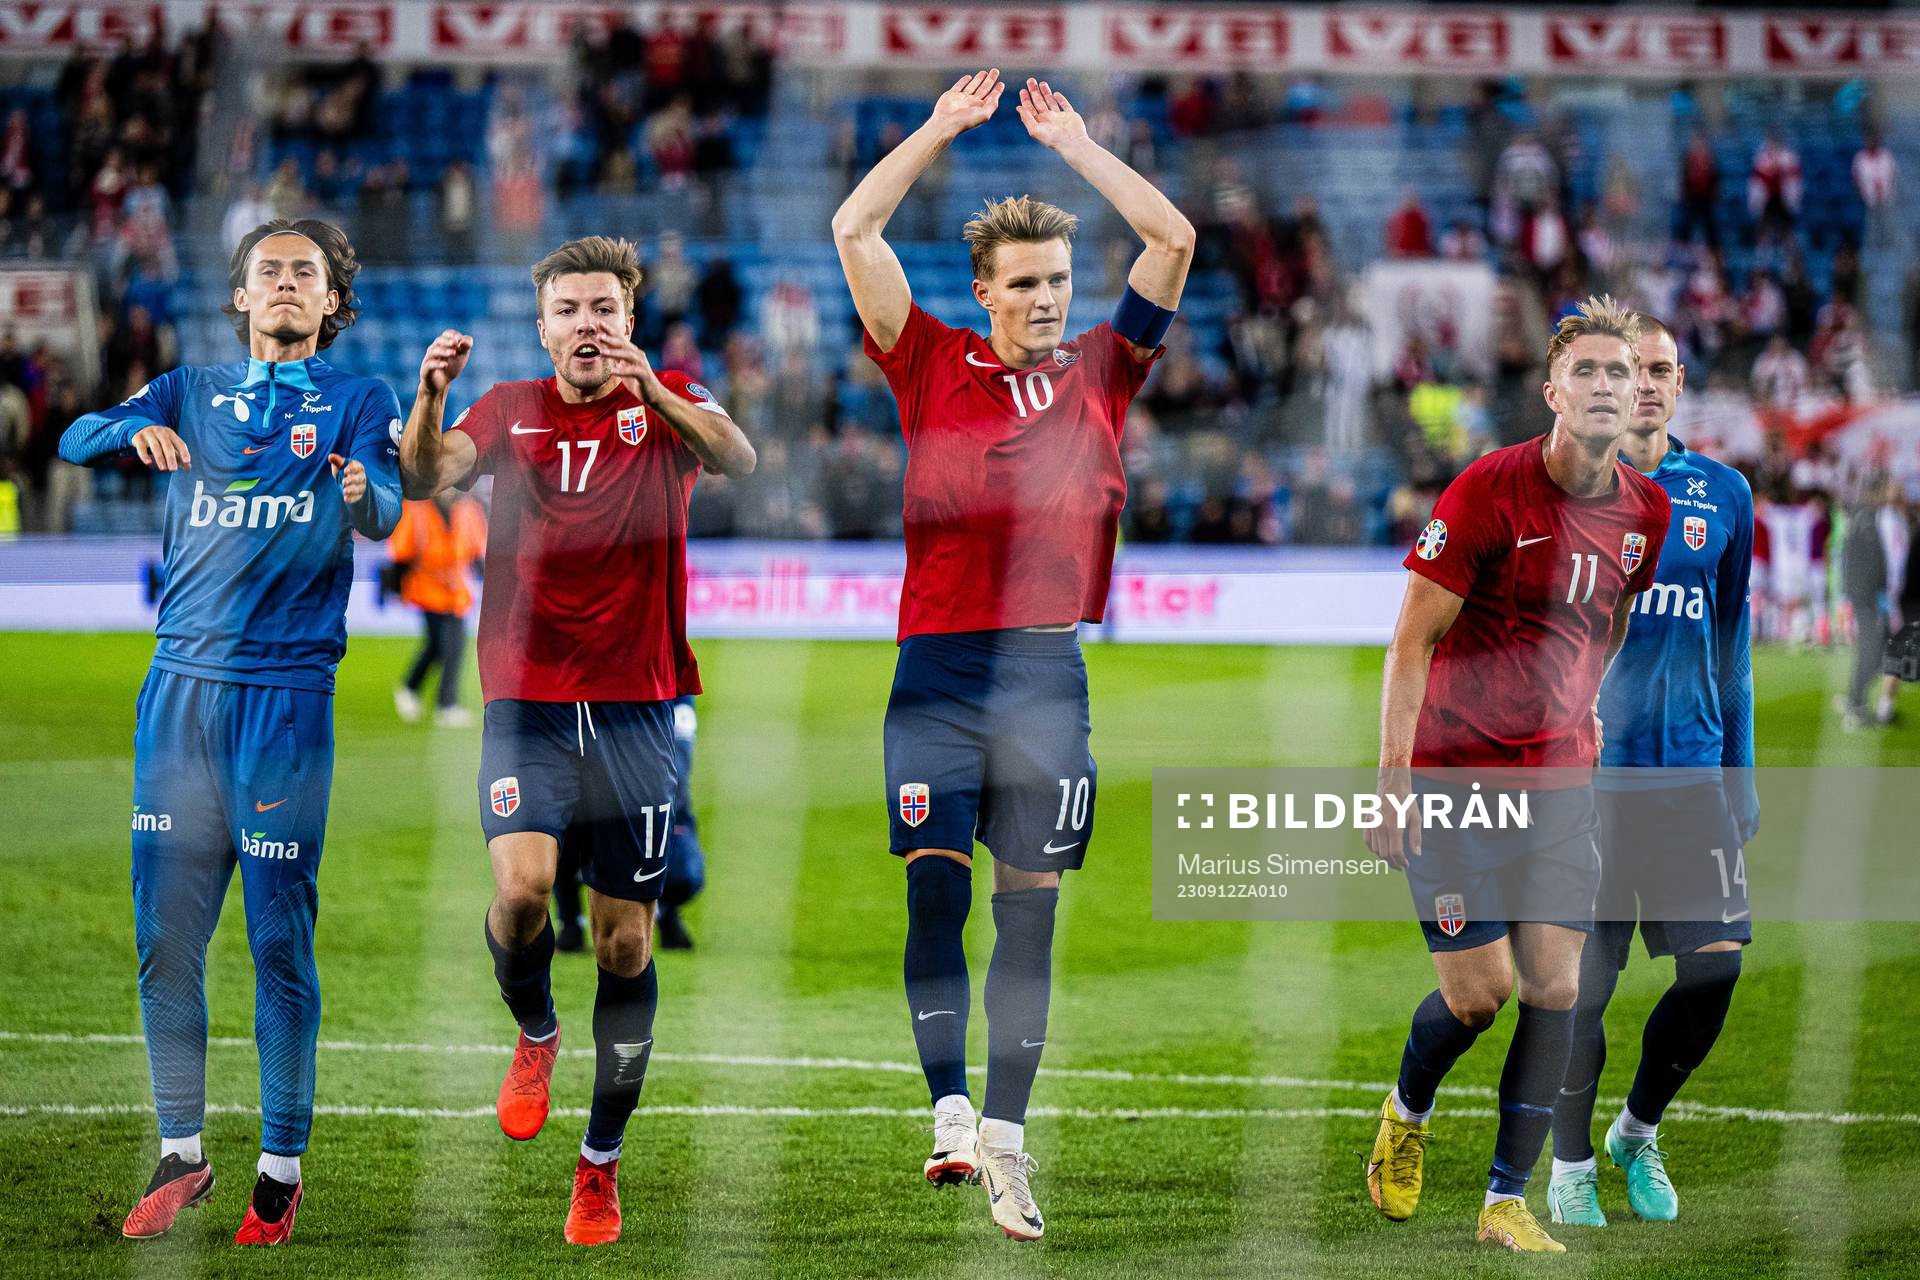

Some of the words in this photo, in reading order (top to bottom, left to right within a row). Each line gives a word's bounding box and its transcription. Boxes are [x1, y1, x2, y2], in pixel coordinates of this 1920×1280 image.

[886, 14, 1053, 57] VG
[1112, 15, 1275, 59] VG
[1334, 15, 1493, 60] VG
[1552, 17, 1712, 62] VG
[1003, 372, 1054, 417] 10
[557, 440, 600, 492] 17
[189, 480, 315, 529] bama
[1670, 497, 1692, 506] Norsk
[1692, 500, 1718, 512] Tipping
[1566, 553, 1599, 604] 11
[1055, 777, 1090, 831] 10
[241, 828, 299, 860] bama
[641, 803, 672, 859] 17
[1710, 848, 1748, 899] 14
